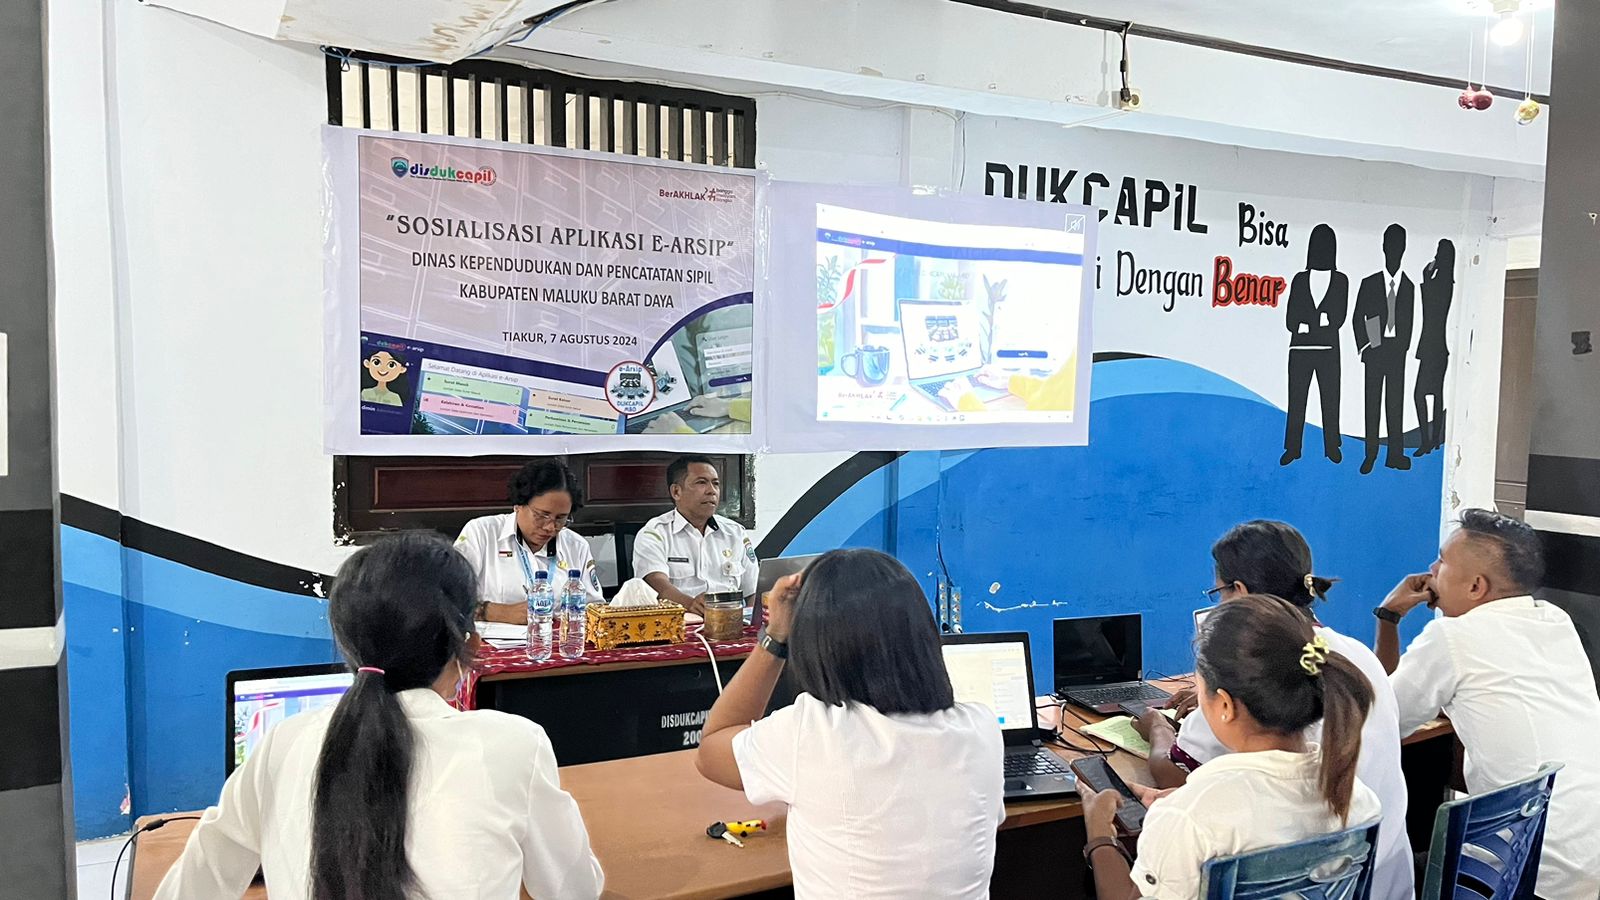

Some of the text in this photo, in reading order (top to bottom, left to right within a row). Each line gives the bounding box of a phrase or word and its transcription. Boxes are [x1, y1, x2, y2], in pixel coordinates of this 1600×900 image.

[410, 164, 492, 183] disdukcapil
[659, 189, 706, 201] BerAKHLAK
[1239, 202, 1289, 248] Bisa
[550, 226, 643, 251] APLIKASI
[412, 251, 713, 284] DINAS KEPENDUDUKAN DAN PENCATATAN SIPIL
[1116, 250, 1203, 312] Dengan
[1212, 255, 1286, 308] Benar
[459, 283, 674, 308] KABUPATEN MALUKU BARAT DAYA
[502, 331, 638, 346] TIAKUR, 7 AGUSTUS 2024
[428, 362, 450, 373] Selamat
[451, 367, 471, 376] Datang
[661, 710, 710, 728] DISDUKCAPI
[683, 730, 702, 745] 200
